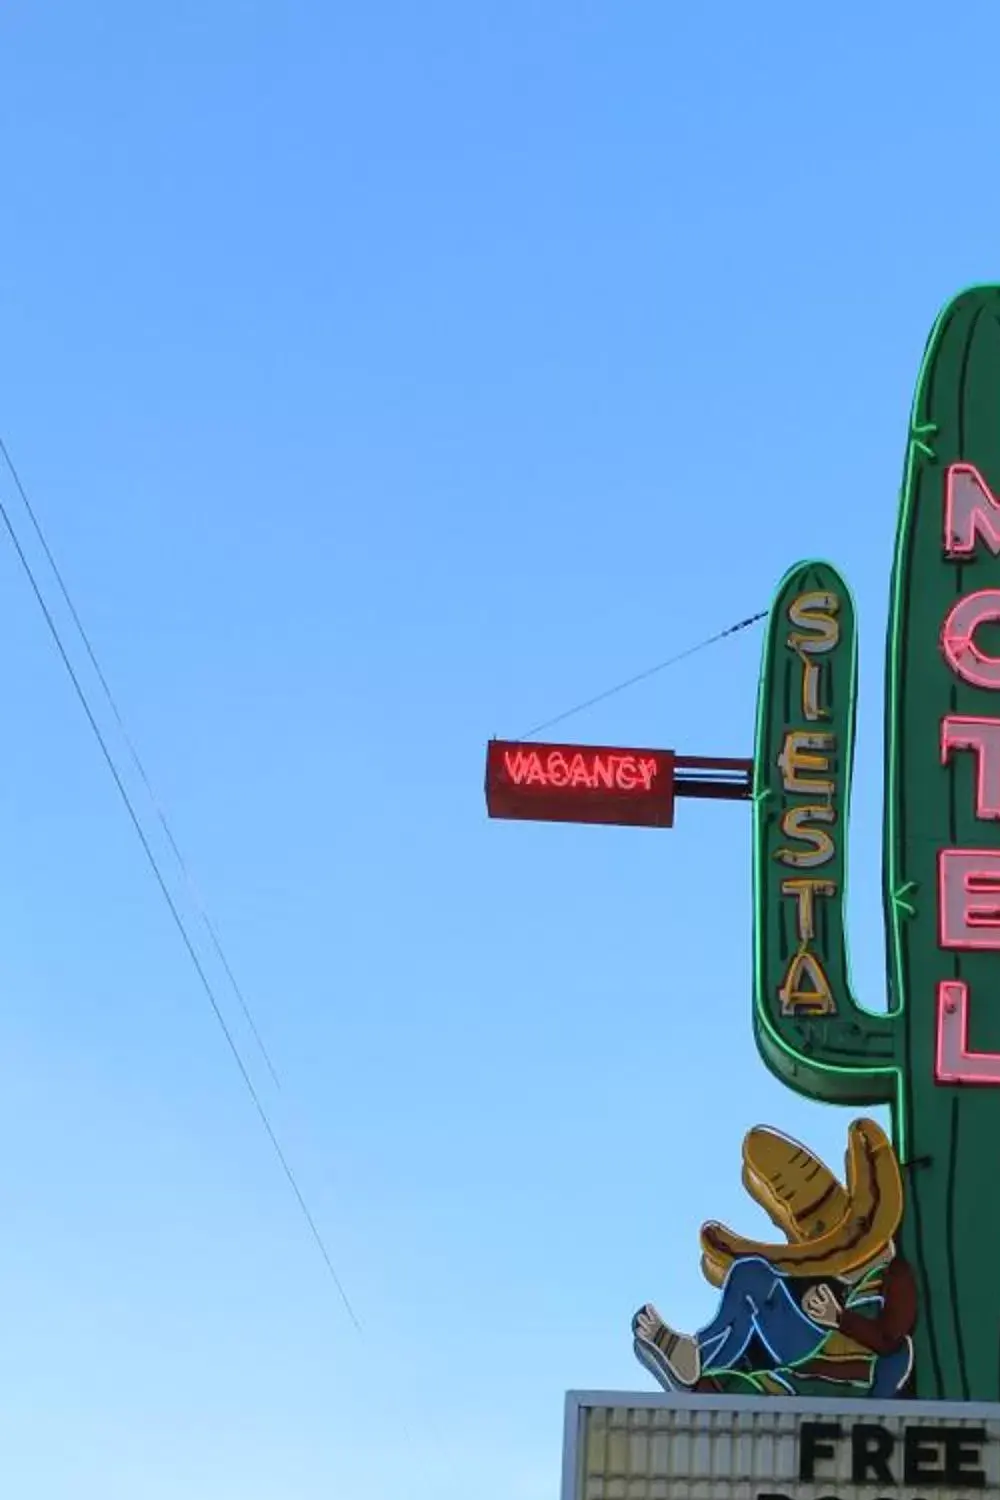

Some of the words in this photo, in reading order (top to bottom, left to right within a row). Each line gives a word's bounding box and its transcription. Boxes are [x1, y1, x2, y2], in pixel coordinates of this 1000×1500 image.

[504, 751, 657, 790] VACANCY
[778, 591, 839, 1015] SIESTA
[801, 1422, 987, 1487] FREE
